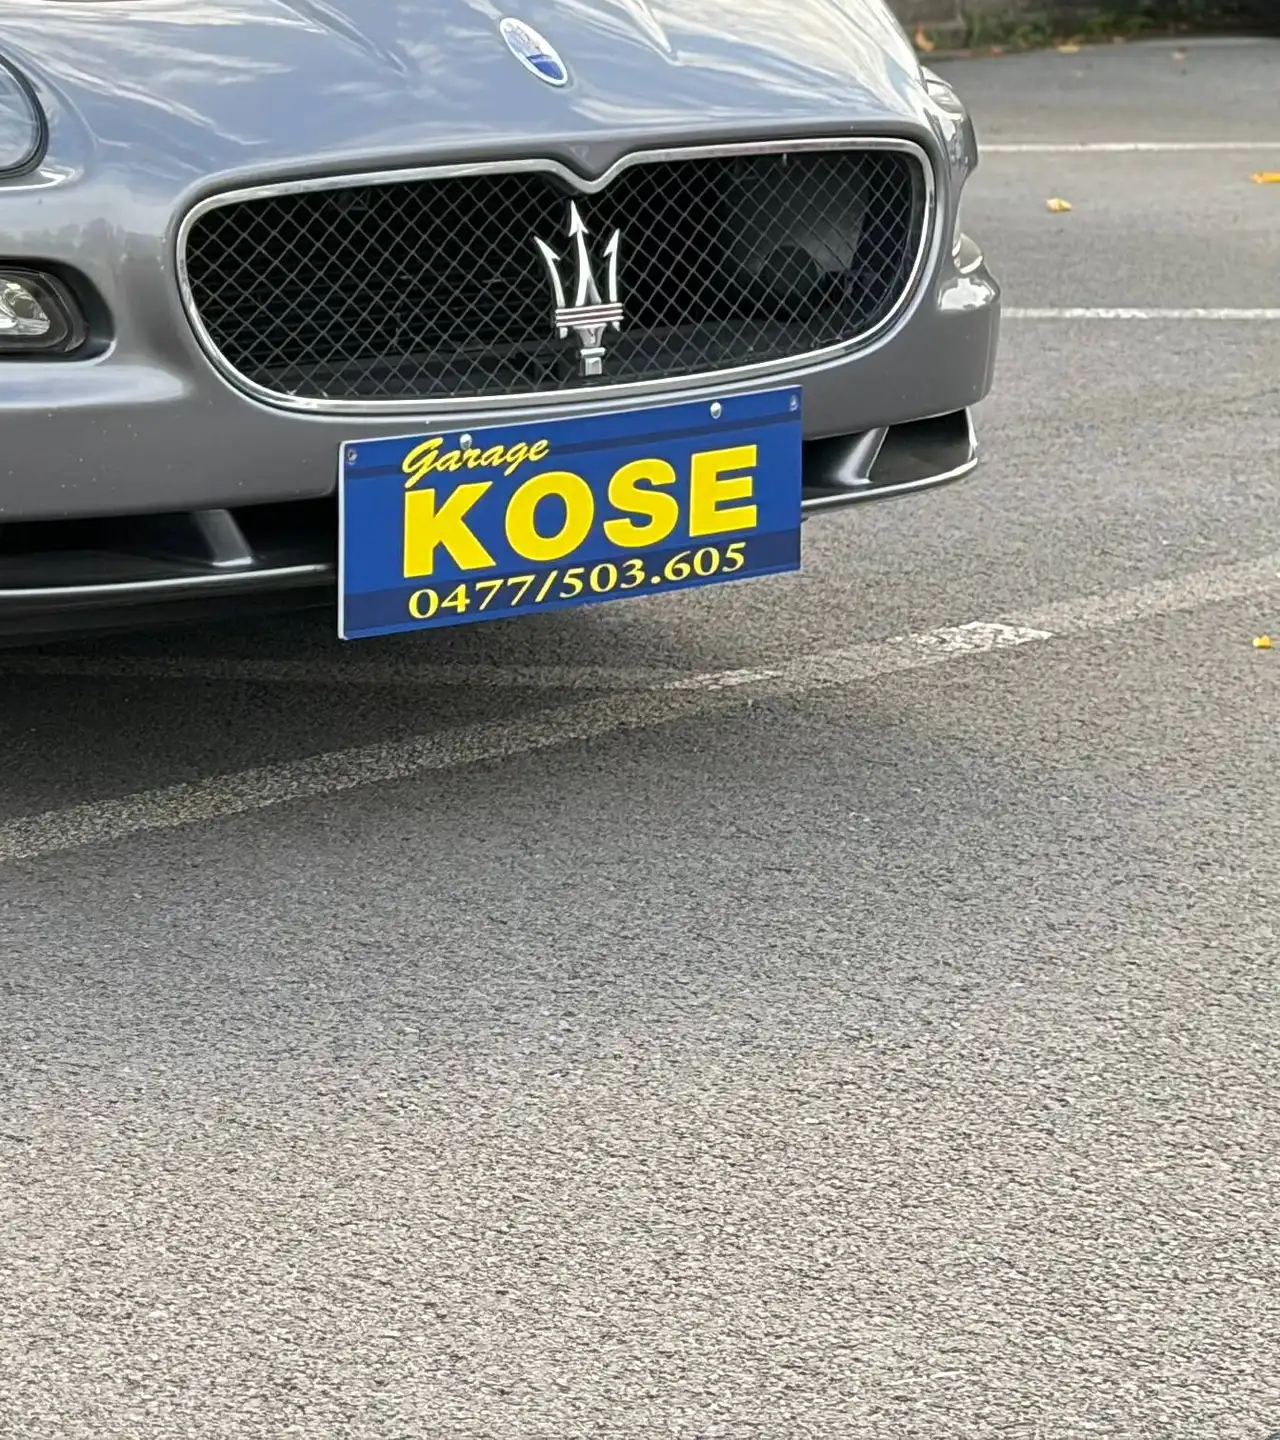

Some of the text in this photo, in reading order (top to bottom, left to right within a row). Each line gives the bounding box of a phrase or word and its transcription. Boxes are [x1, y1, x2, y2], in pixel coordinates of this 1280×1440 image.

[401, 437, 550, 489] Garage
[403, 444, 758, 579] KOSE
[408, 542, 747, 620] 0477/503.605
